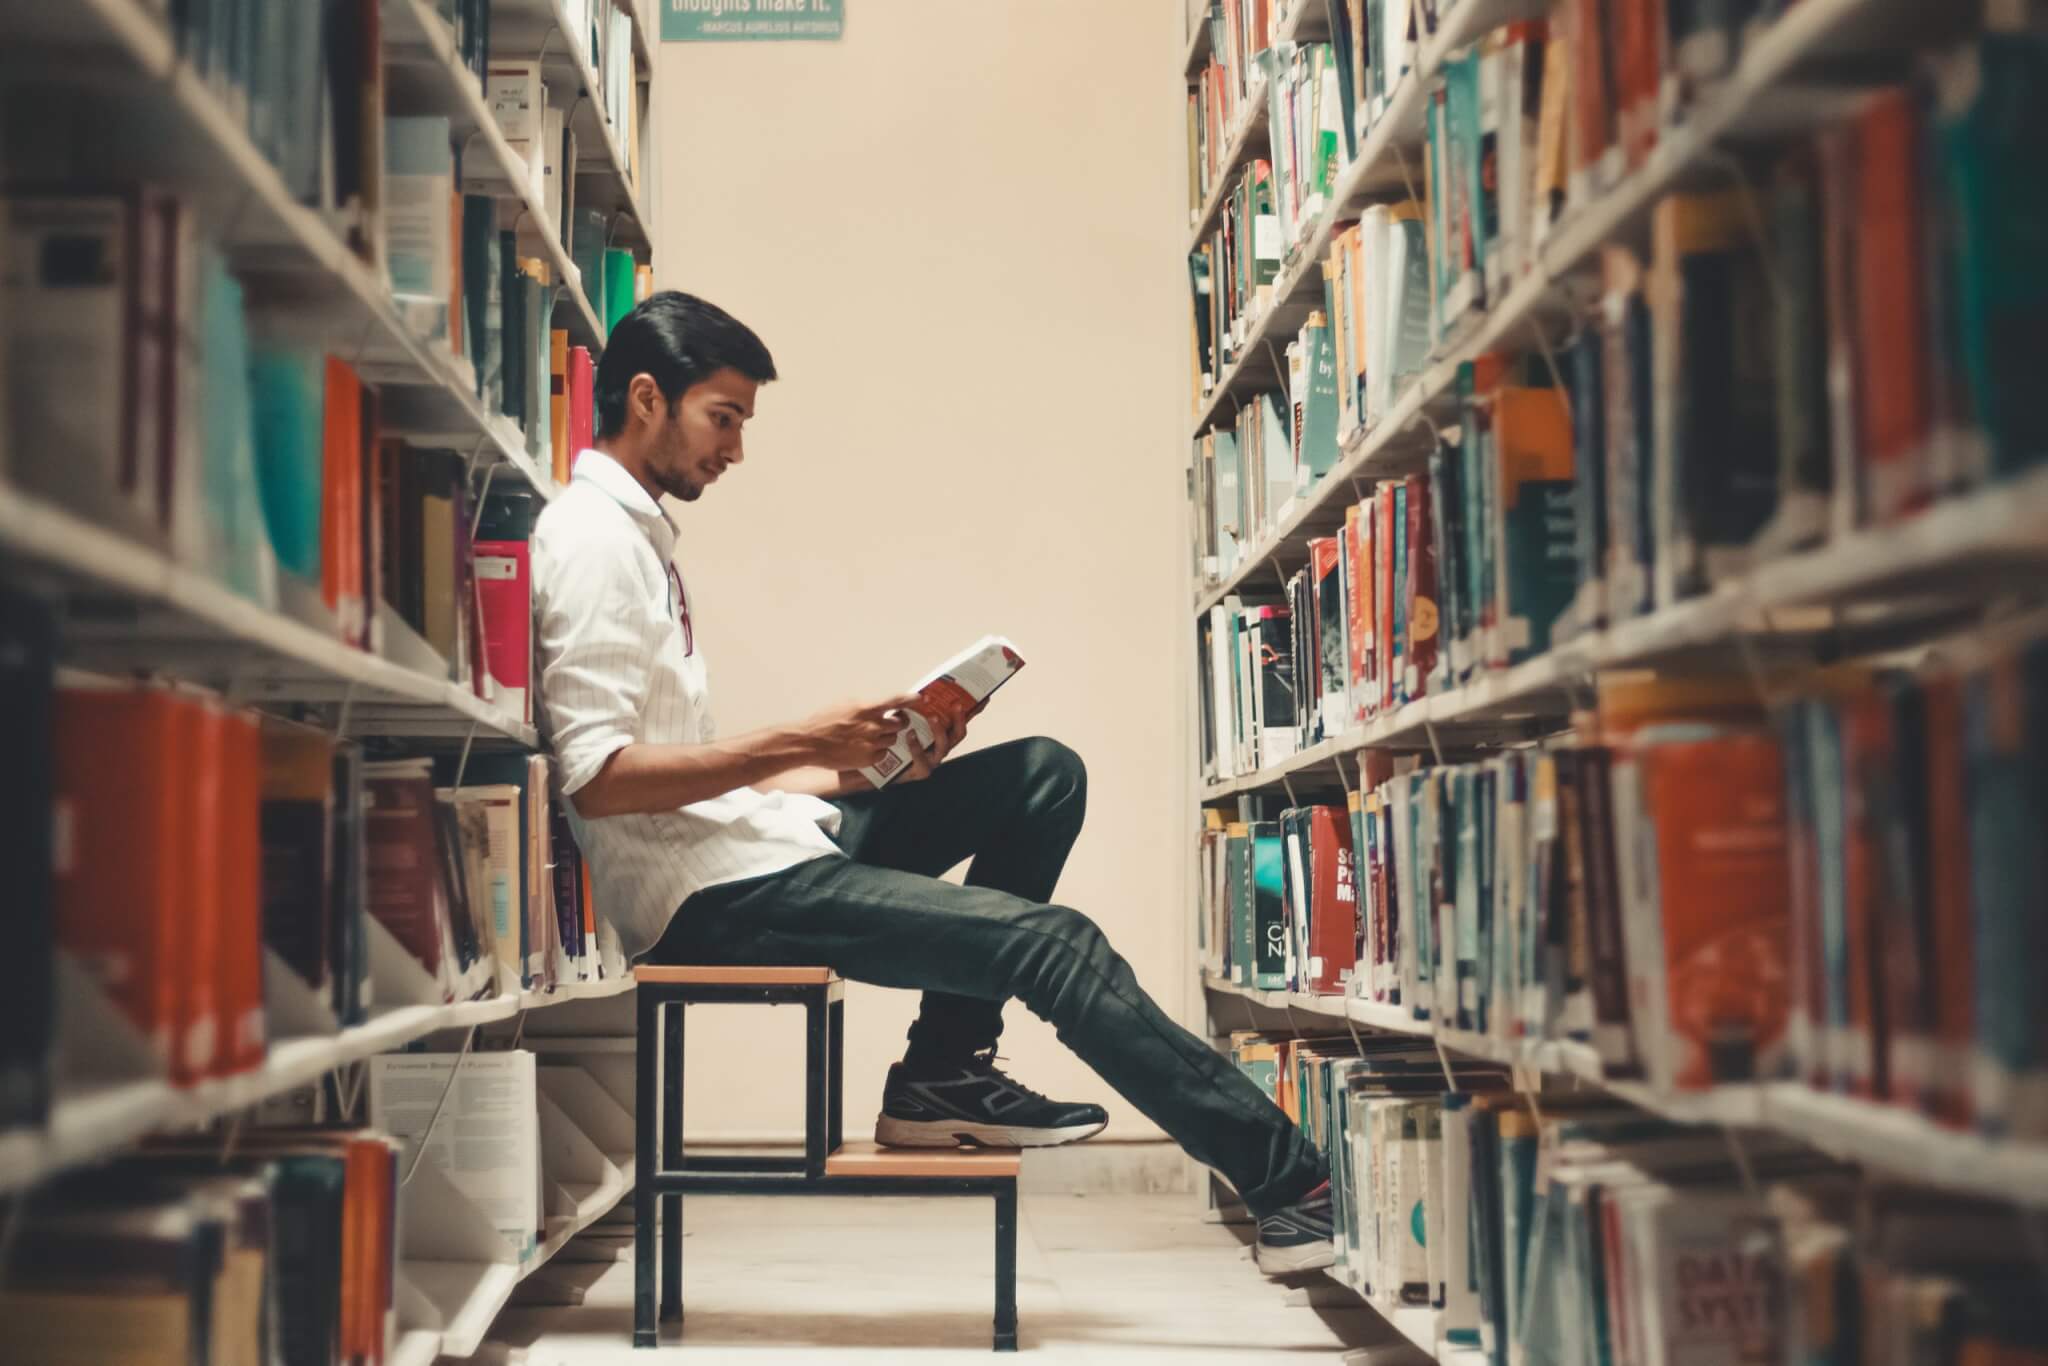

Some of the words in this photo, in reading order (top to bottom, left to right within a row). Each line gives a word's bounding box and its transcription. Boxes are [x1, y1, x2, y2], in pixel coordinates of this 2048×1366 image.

[756, 0, 805, 12] make
[1267, 925, 1285, 942] C
[1268, 942, 1286, 957] N
